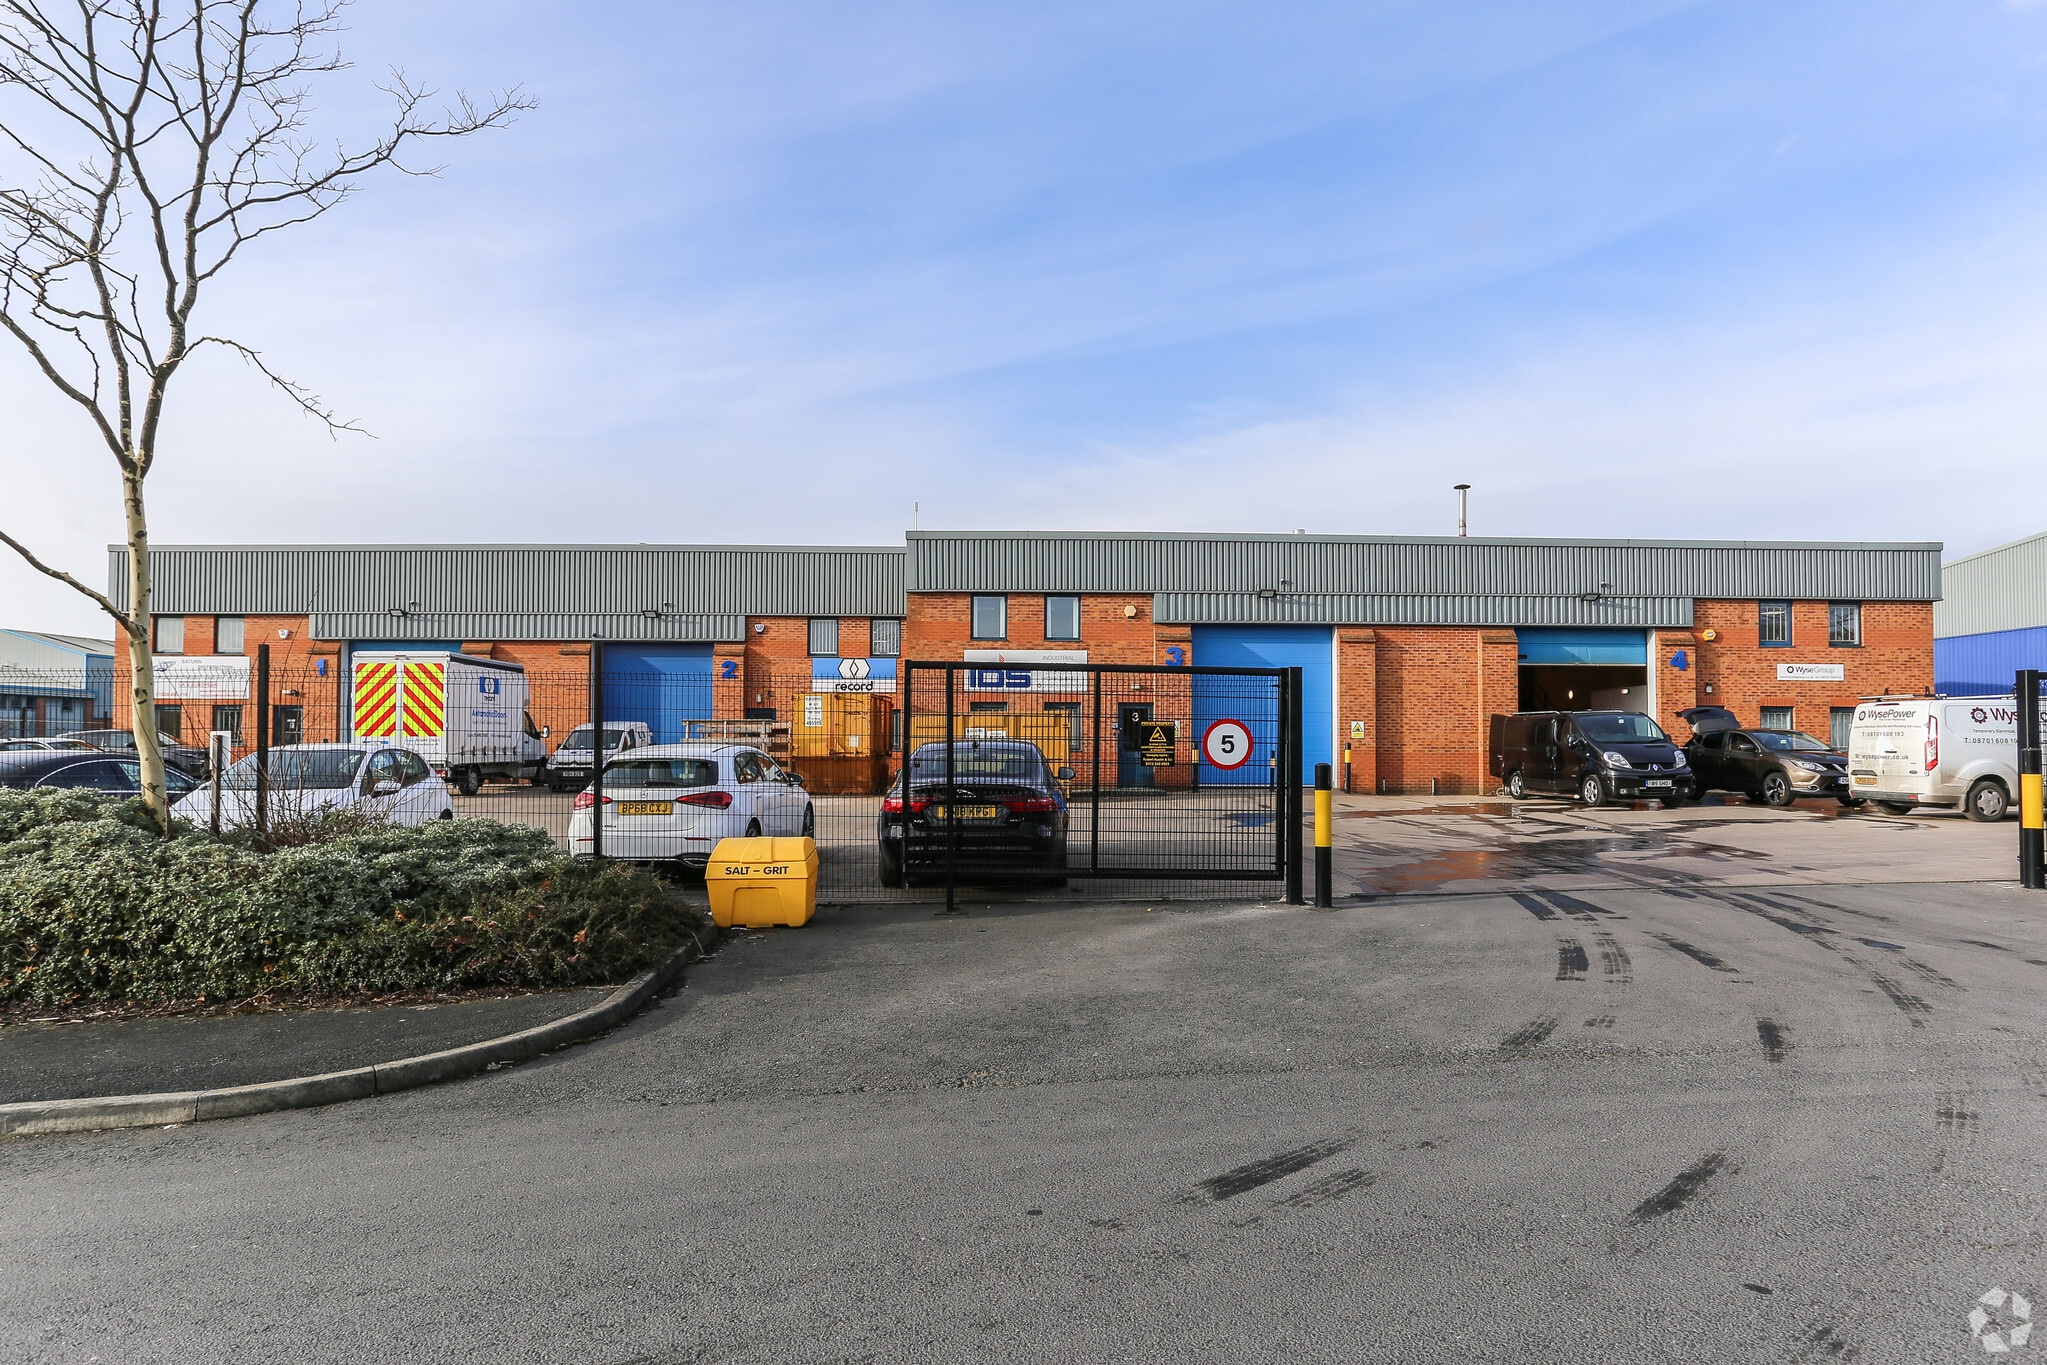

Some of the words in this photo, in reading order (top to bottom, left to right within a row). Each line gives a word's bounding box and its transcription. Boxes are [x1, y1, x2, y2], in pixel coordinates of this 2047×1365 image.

[1166, 646, 1183, 666] 3
[1669, 650, 1687, 670] 4
[315, 658, 326, 677] 1
[721, 661, 737, 679] 2
[1795, 665, 1835, 674] WyseGroup
[835, 681, 873, 691] record
[1131, 712, 1139, 721] 3
[1867, 709, 1917, 720] WysePower
[1221, 735, 1235, 753] 5
[649, 803, 668, 812] CXJ
[725, 866, 751, 875] SALT
[763, 866, 789, 874] GRIT
